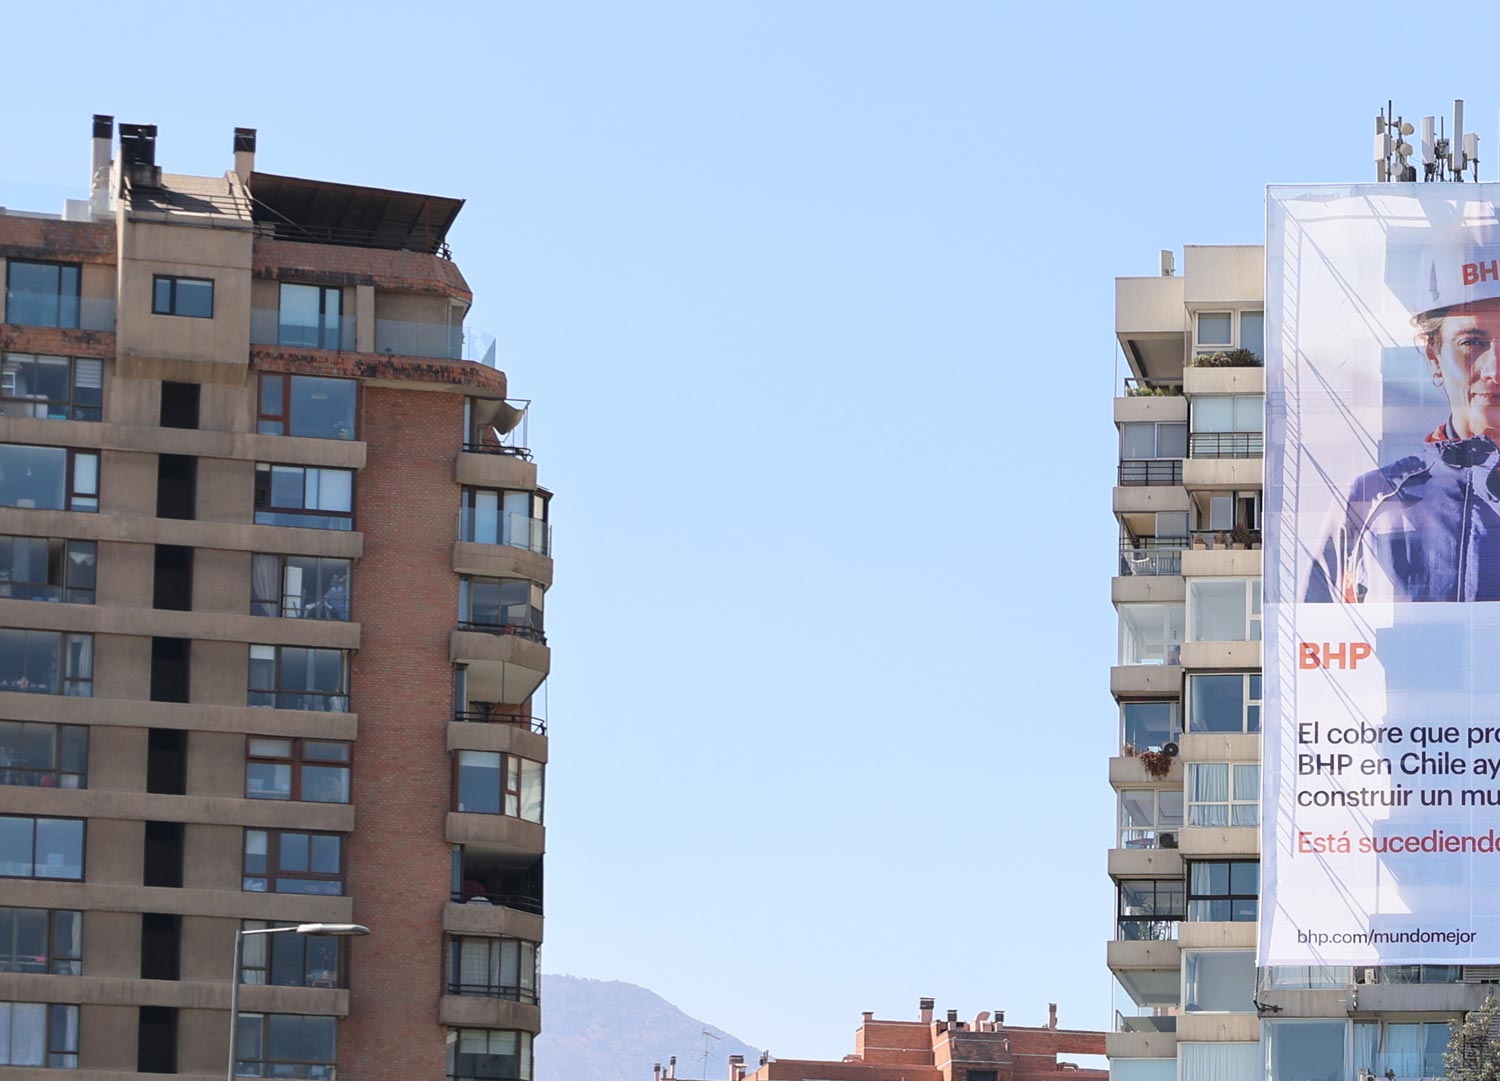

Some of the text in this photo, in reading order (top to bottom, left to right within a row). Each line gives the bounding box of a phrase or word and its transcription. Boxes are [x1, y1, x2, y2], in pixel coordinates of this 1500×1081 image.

[1298, 641, 1371, 670] BHP
[1298, 721, 1320, 745] El
[1327, 721, 1403, 745] cobre
[1410, 727, 1460, 749] que
[1298, 753, 1352, 776] BHP
[1360, 757, 1392, 776] en
[1400, 752, 1466, 775] Chile
[1297, 784, 1413, 808] construir
[1420, 788, 1453, 806] un
[1298, 830, 1351, 854] Está
[1297, 928, 1477, 947] bhp.com/mundomejor
